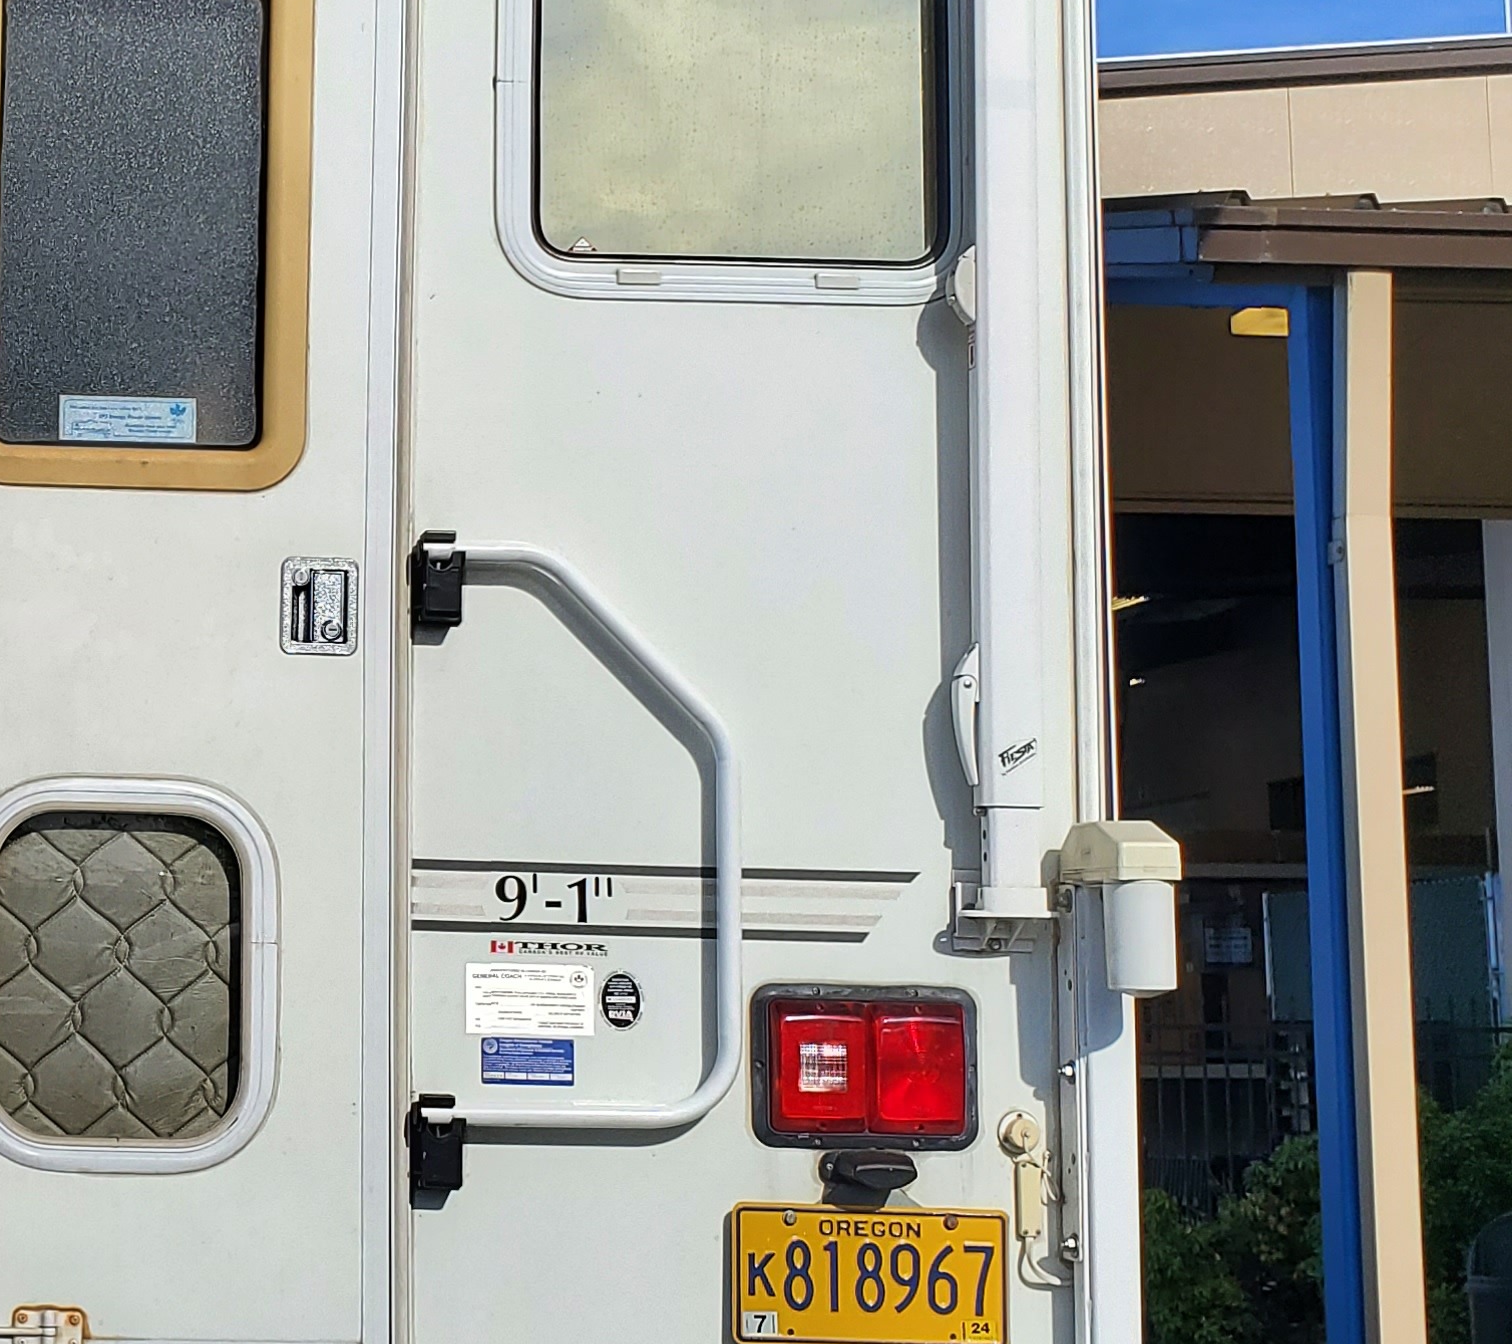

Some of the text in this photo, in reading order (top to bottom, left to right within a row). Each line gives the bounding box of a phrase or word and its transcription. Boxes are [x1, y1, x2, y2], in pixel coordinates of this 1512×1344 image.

[495, 873, 613, 923] 9'-1"
[514, 941, 608, 952] THOR
[819, 1219, 921, 1238] OREGON
[748, 1239, 995, 1317] K818967
[754, 1315, 767, 1333] 7
[971, 1322, 991, 1334] 24
